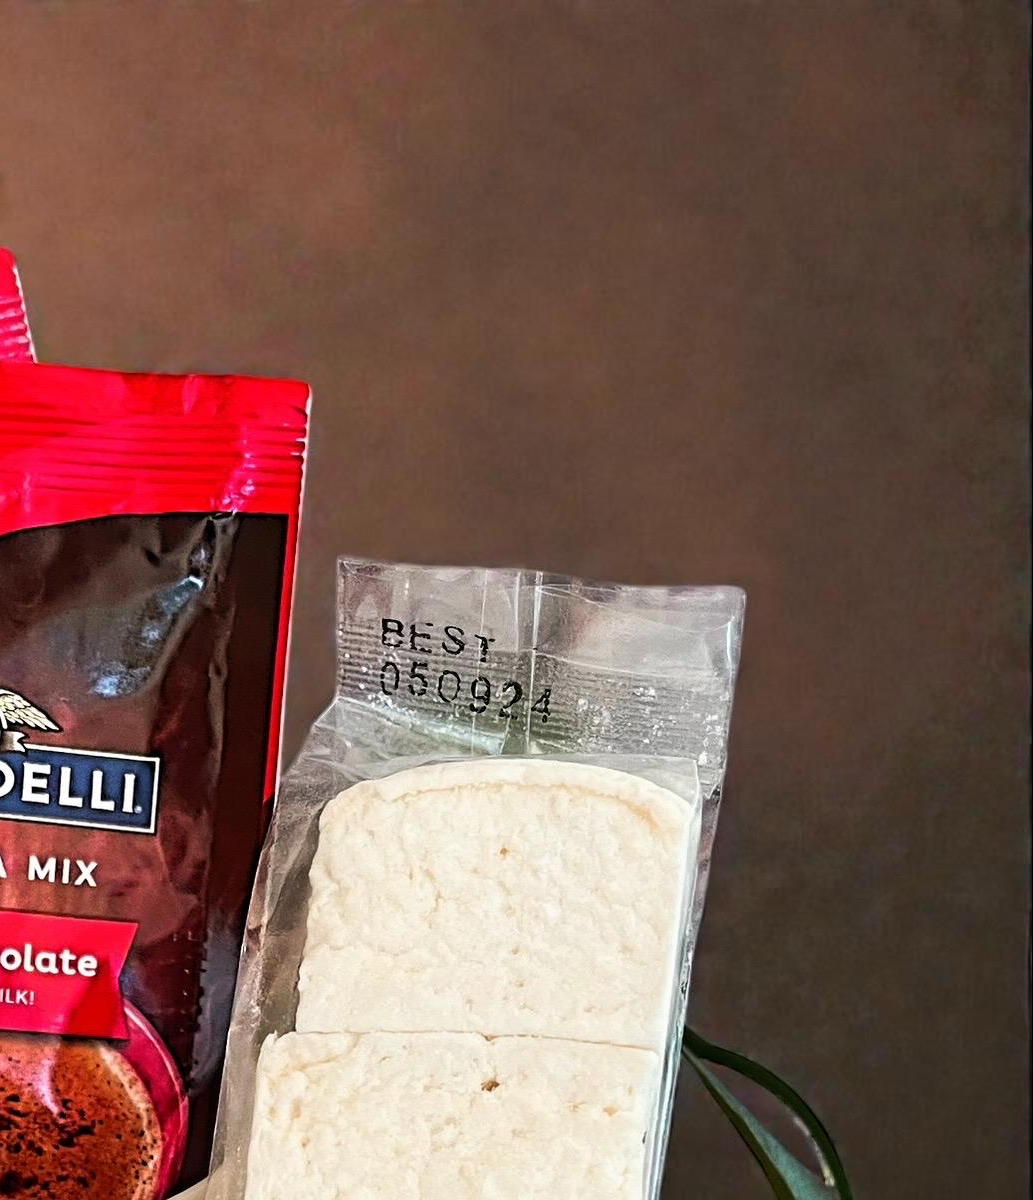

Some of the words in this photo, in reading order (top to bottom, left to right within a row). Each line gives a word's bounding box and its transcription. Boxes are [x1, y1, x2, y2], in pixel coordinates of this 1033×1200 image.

[381, 618, 496, 662] BEST
[380, 661, 552, 723] 050924
[28, 854, 98, 888] MIX
